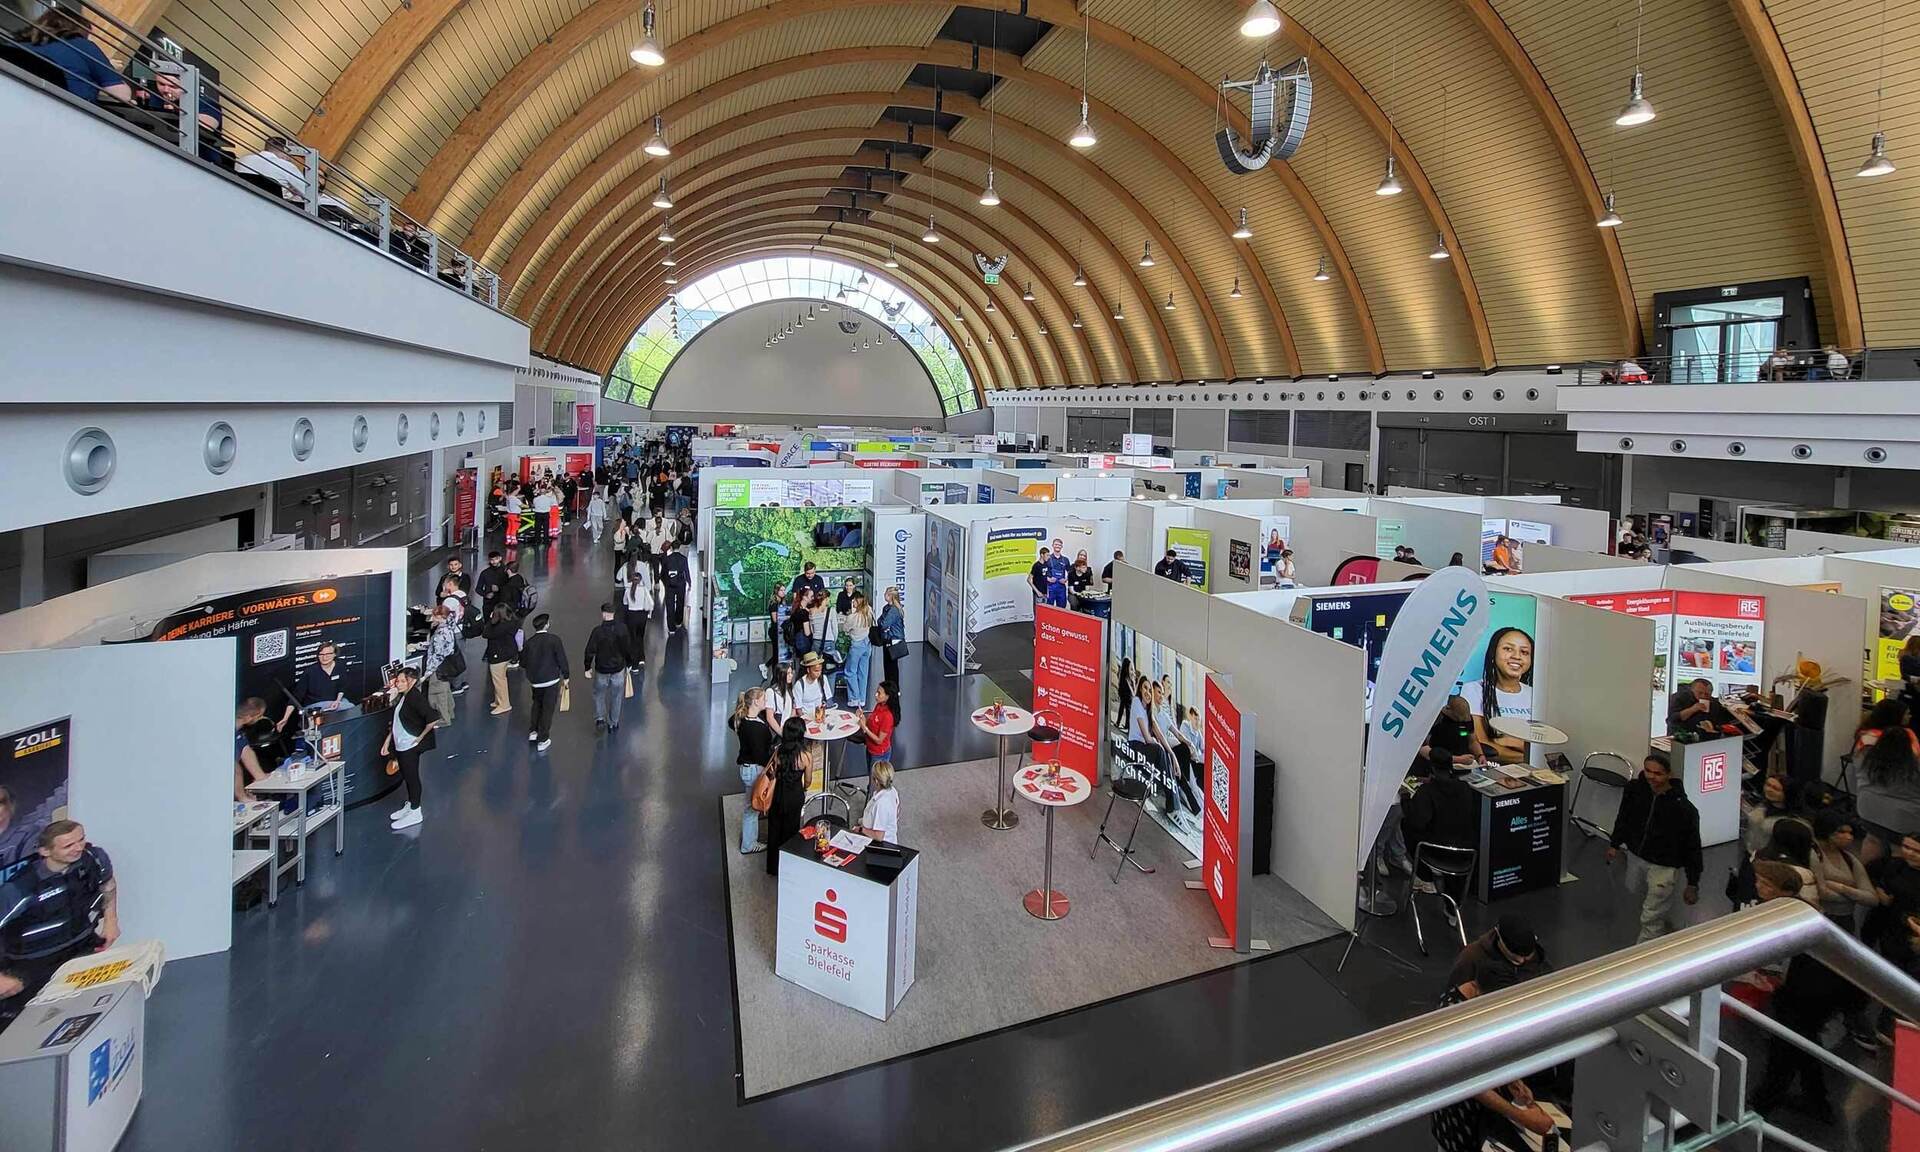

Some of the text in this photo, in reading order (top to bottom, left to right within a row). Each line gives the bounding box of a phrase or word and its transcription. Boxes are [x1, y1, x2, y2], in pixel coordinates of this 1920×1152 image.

[1468, 416, 1497, 426] OST 1
[780, 443, 800, 466] SPACE
[242, 595, 310, 616] VORWÄRTS.
[1315, 601, 1351, 611] SIEMENS
[1740, 600, 1759, 613] RTS
[188, 610, 235, 635] KARRIERE
[213, 625, 226, 637] bei
[227, 618, 260, 632] Häfner.
[1041, 622, 1090, 643] Schon gewusst,
[1684, 620, 1753, 630] Ausbildungsberufe
[1041, 632, 1056, 642] dass
[1717, 629, 1750, 638] Bielefeld
[1381, 588, 1478, 739] SIEMENS
[1499, 707, 1532, 716] SIEME
[14, 727, 63, 751] ZOLL
[1115, 735, 1136, 761] Dein
[1137, 751, 1162, 782] Platz
[1162, 770, 1177, 794] ist
[1115, 754, 1136, 780] noch
[1704, 758, 1723, 782] RTS
[1495, 797, 1521, 809] SIEMENS
[1510, 815, 1528, 827] Alles
[804, 938, 855, 969] Sparkasse
[807, 954, 851, 982] Bielefeld
